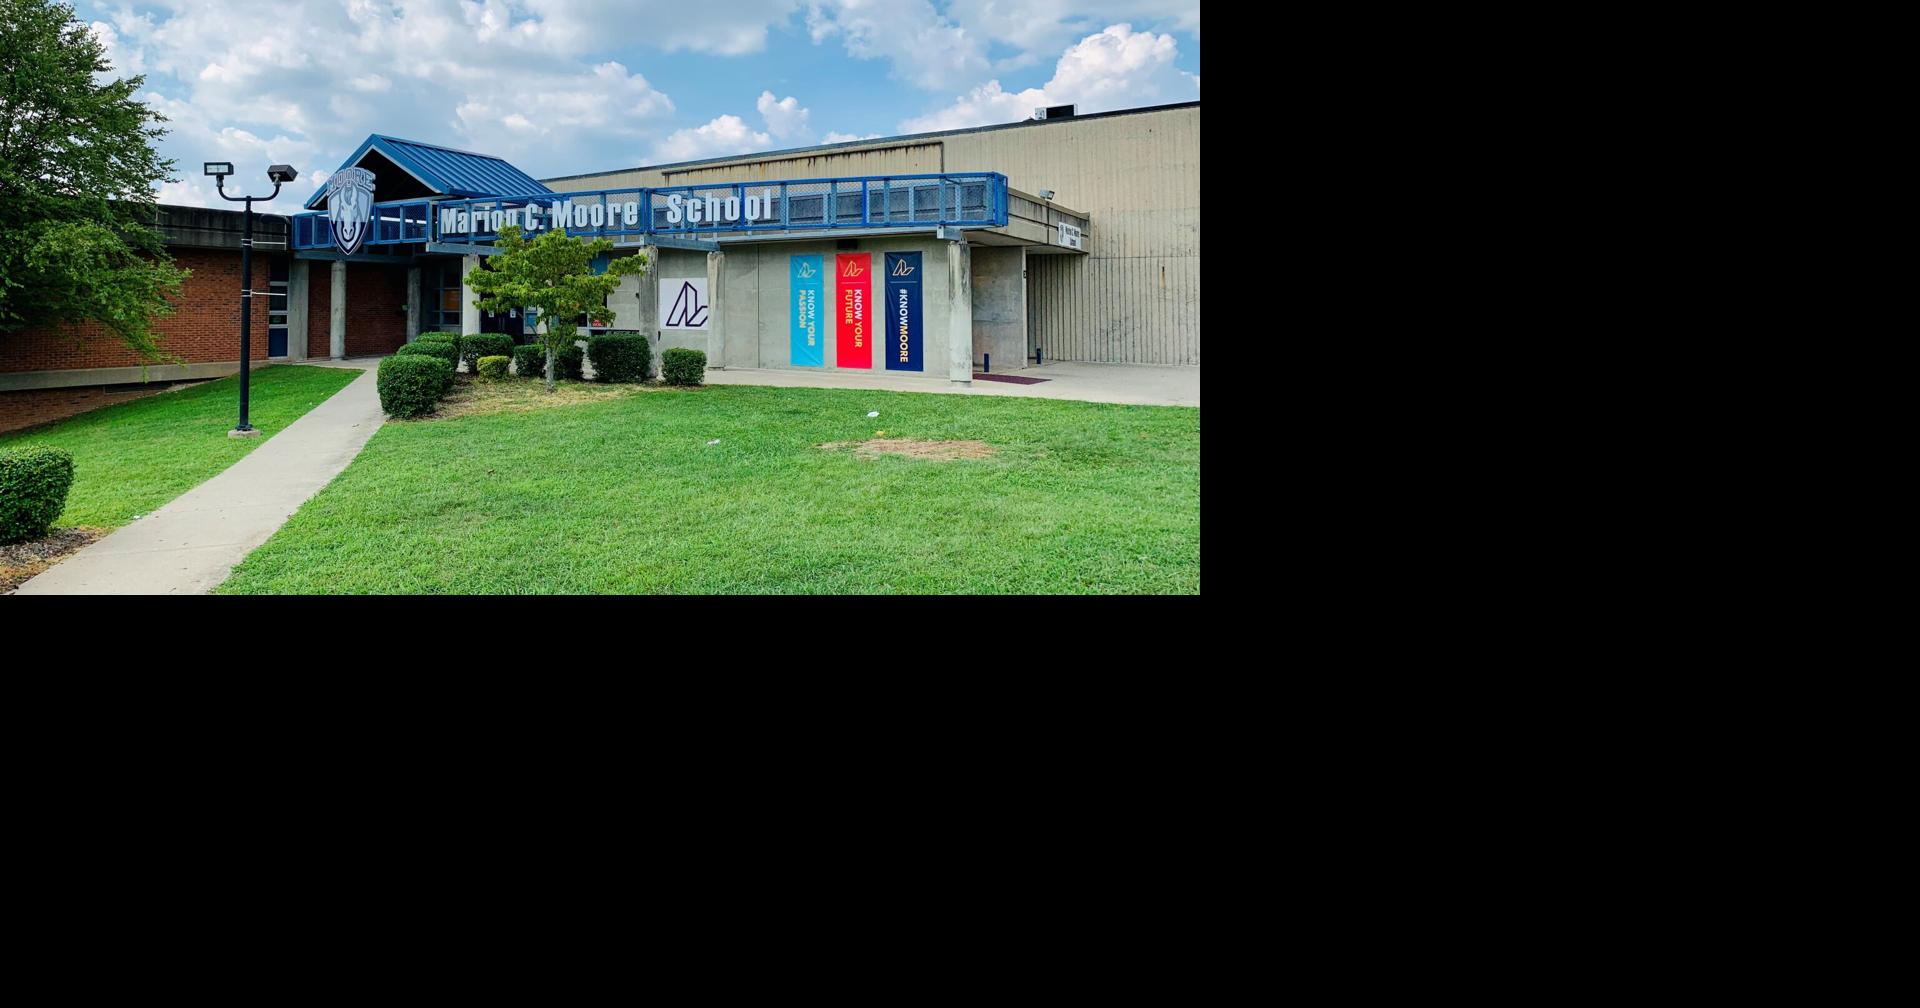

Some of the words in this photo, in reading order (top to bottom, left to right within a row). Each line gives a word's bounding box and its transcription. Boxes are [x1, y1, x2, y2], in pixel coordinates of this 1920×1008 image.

[326, 167, 376, 196] MOORE
[441, 206, 517, 233] Marion
[525, 203, 545, 231] C.
[552, 199, 638, 228] Moore
[667, 189, 772, 223] School
[799, 289, 807, 328] PASSION
[807, 289, 815, 318] KNOW
[845, 289, 853, 324] FUTURE
[854, 289, 862, 320] KNOW
[807, 319, 816, 346] YOUR
[854, 321, 862, 348] YOUR
[899, 288, 908, 363] #KNOWMOORE
